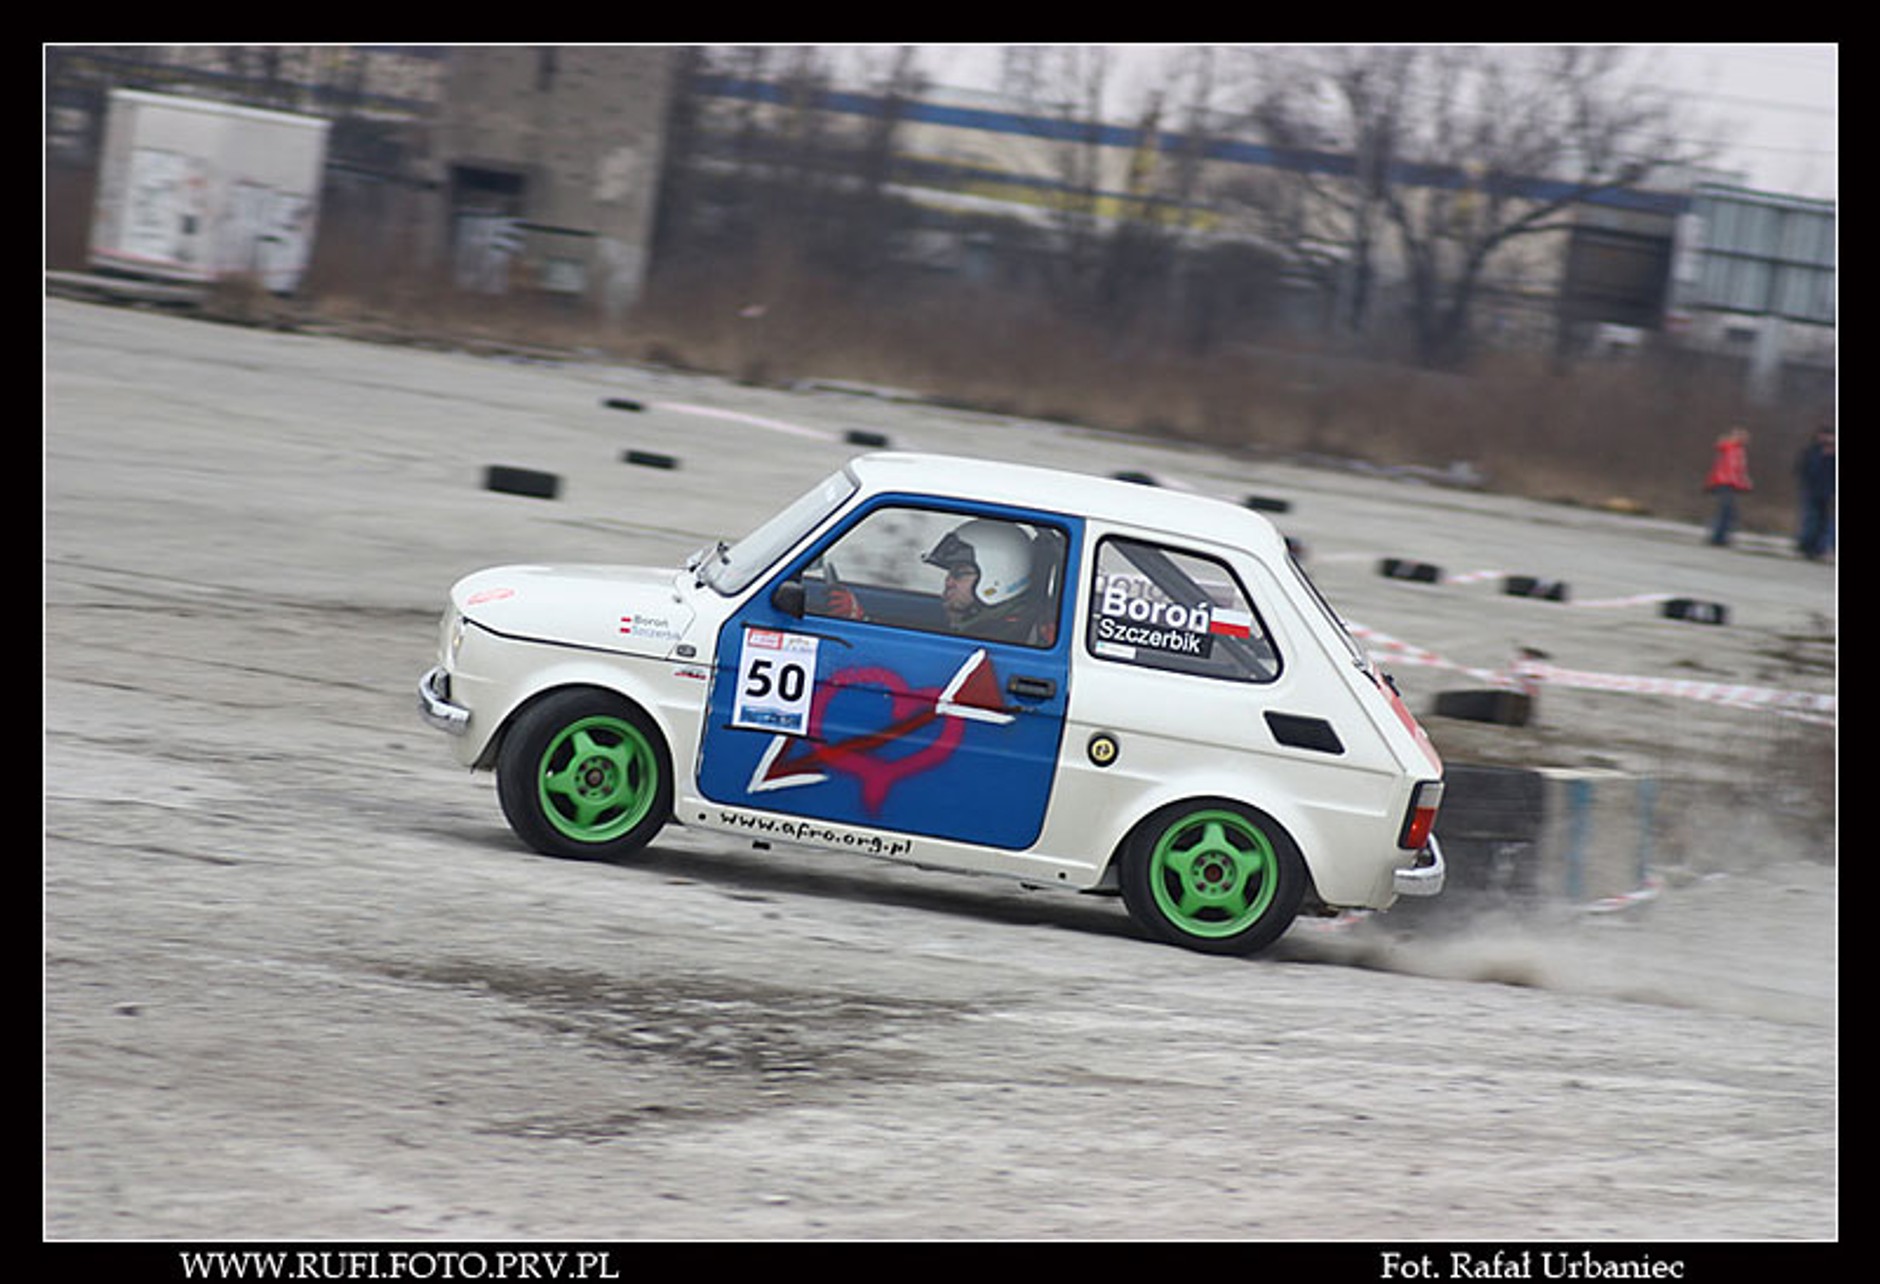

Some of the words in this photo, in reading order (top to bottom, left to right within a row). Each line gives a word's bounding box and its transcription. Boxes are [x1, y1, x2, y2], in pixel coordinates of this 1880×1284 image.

[1102, 586, 1209, 634] Boroń
[1099, 618, 1200, 653] Szczerbik
[745, 658, 806, 702] 50
[720, 812, 912, 855] www.afro.org.pl
